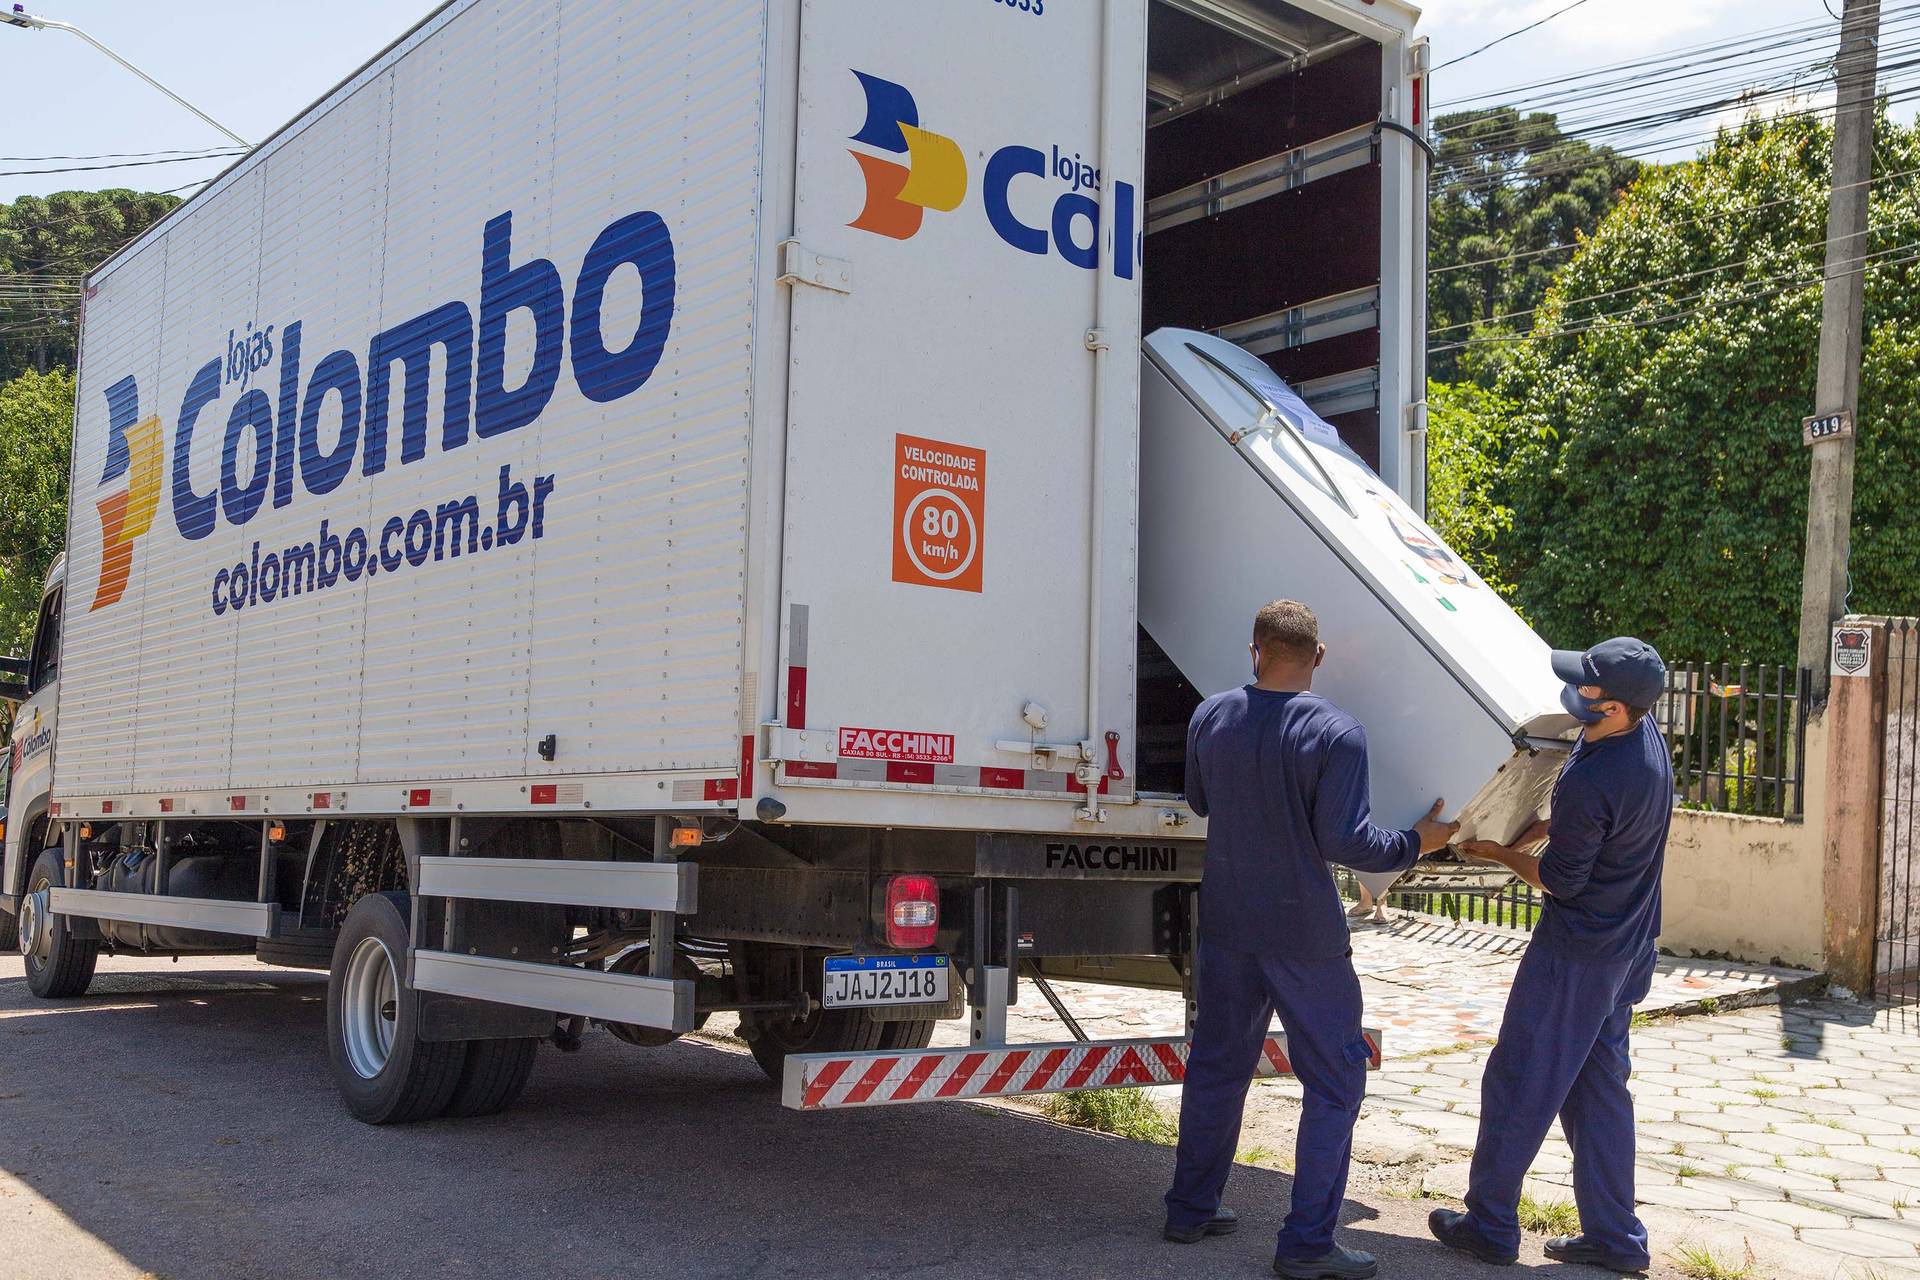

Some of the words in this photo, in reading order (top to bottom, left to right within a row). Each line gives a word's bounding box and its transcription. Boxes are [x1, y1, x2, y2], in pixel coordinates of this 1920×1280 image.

[983, 146, 1142, 281] Col
[226, 321, 274, 388] lojas
[172, 210, 676, 540] Colombo
[1812, 417, 1839, 437] 319
[904, 445, 976, 472] VELOCIDADE
[901, 464, 979, 491] CONTROLADA
[922, 506, 959, 538] 80
[212, 464, 555, 616] colombo.com.br
[922, 540, 959, 565] km/h
[23, 727, 51, 758] Colombo
[840, 729, 950, 755] FACCHINI
[1046, 844, 1177, 871] FACCHINI
[876, 960, 897, 968] BRASIL
[836, 971, 936, 1001] JAJ2J18
[826, 995, 834, 1005] BR
